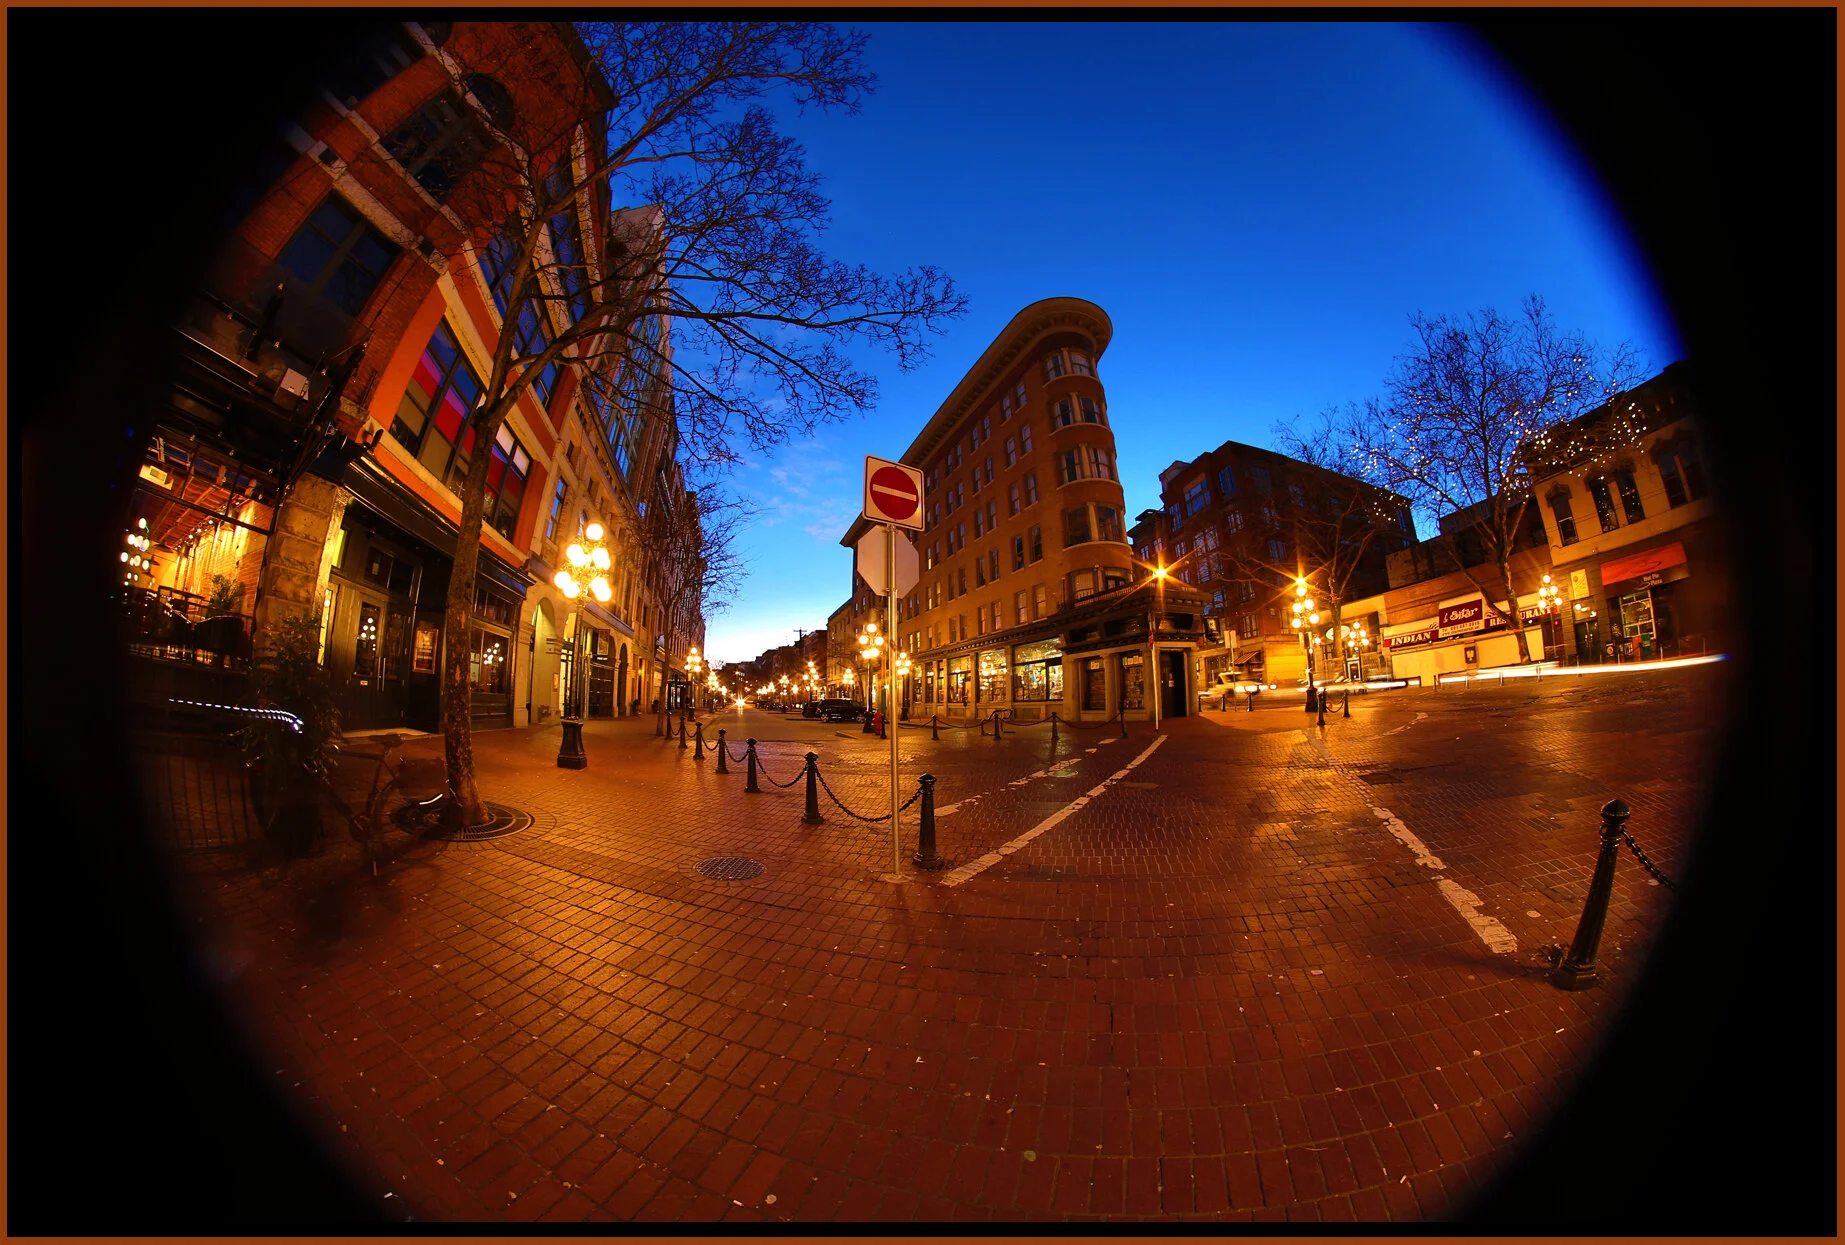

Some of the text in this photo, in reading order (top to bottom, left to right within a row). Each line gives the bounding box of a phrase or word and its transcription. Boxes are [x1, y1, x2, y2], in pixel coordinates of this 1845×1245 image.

[1449, 608, 1478, 620] Sitar
[1489, 605, 1551, 627] RESURANT
[1391, 631, 1431, 646] INDIAN
